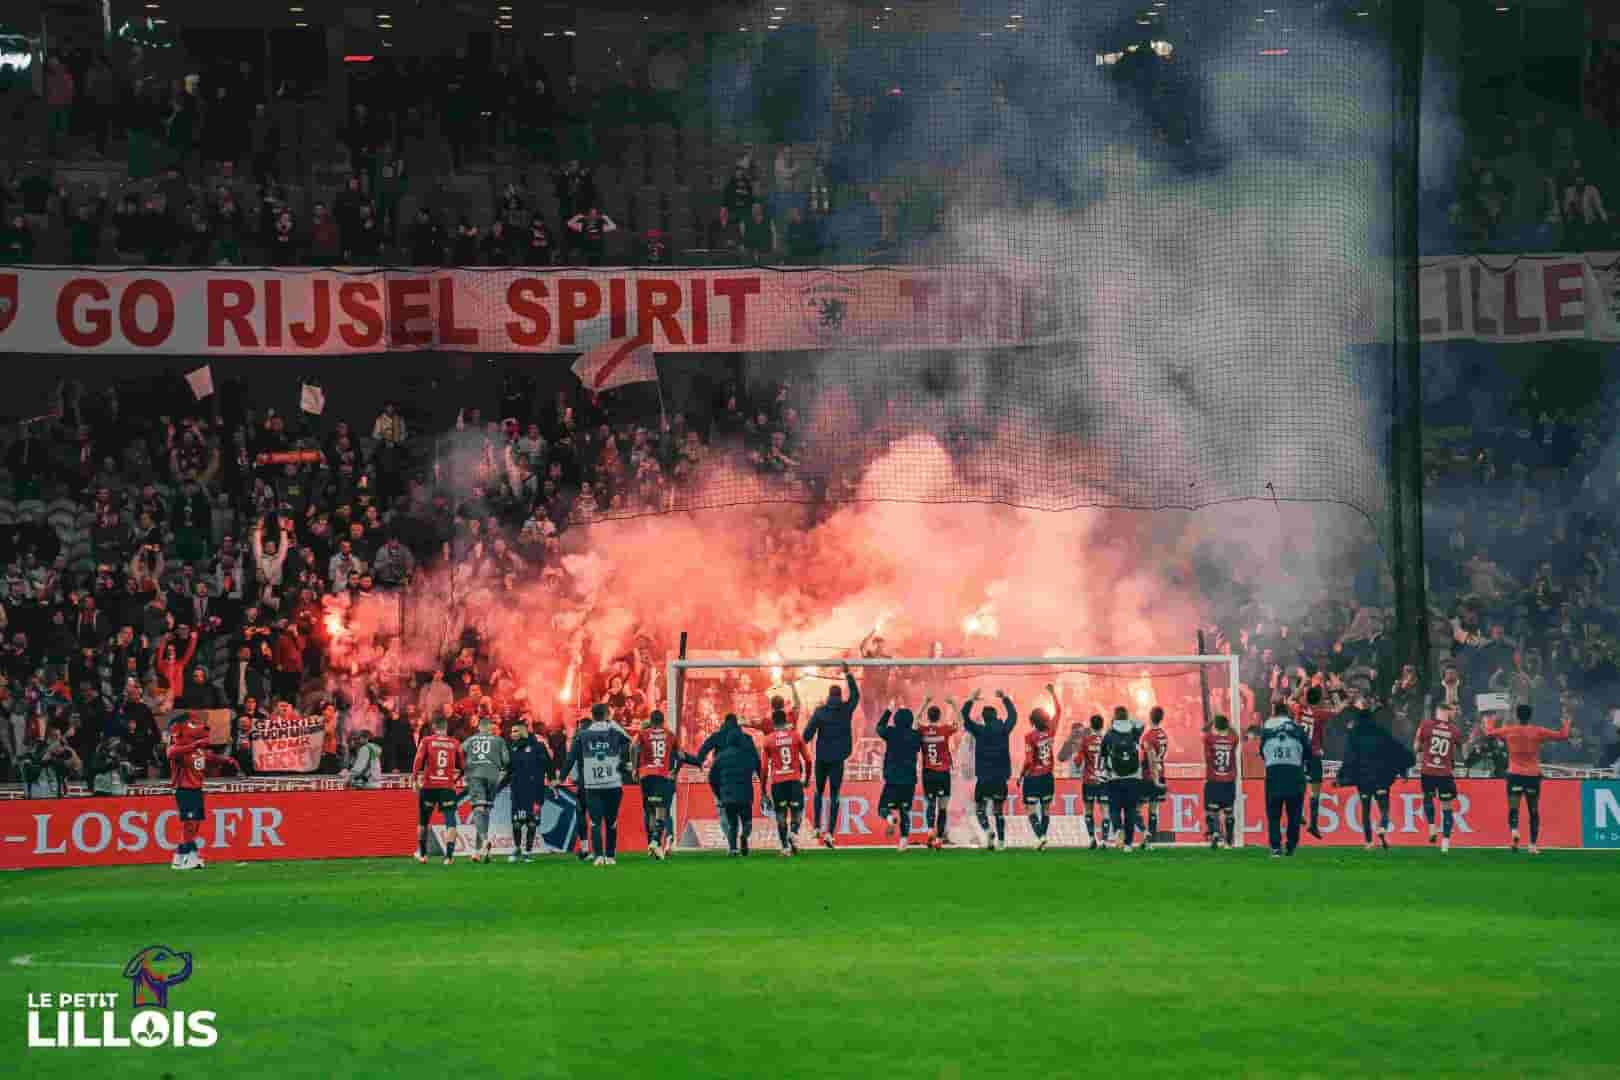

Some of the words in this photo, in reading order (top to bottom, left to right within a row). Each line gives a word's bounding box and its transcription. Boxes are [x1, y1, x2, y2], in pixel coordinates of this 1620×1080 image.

[56, 278, 174, 348] GO
[207, 278, 480, 348] RIJSEL
[505, 276, 760, 348] SPIRIT
[470, 740, 491, 754] 30
[652, 741, 666, 759] 18
[781, 746, 792, 765] 9
[927, 743, 938, 760] 5
[1429, 736, 1450, 757] 20
[437, 750, 448, 768] 6
